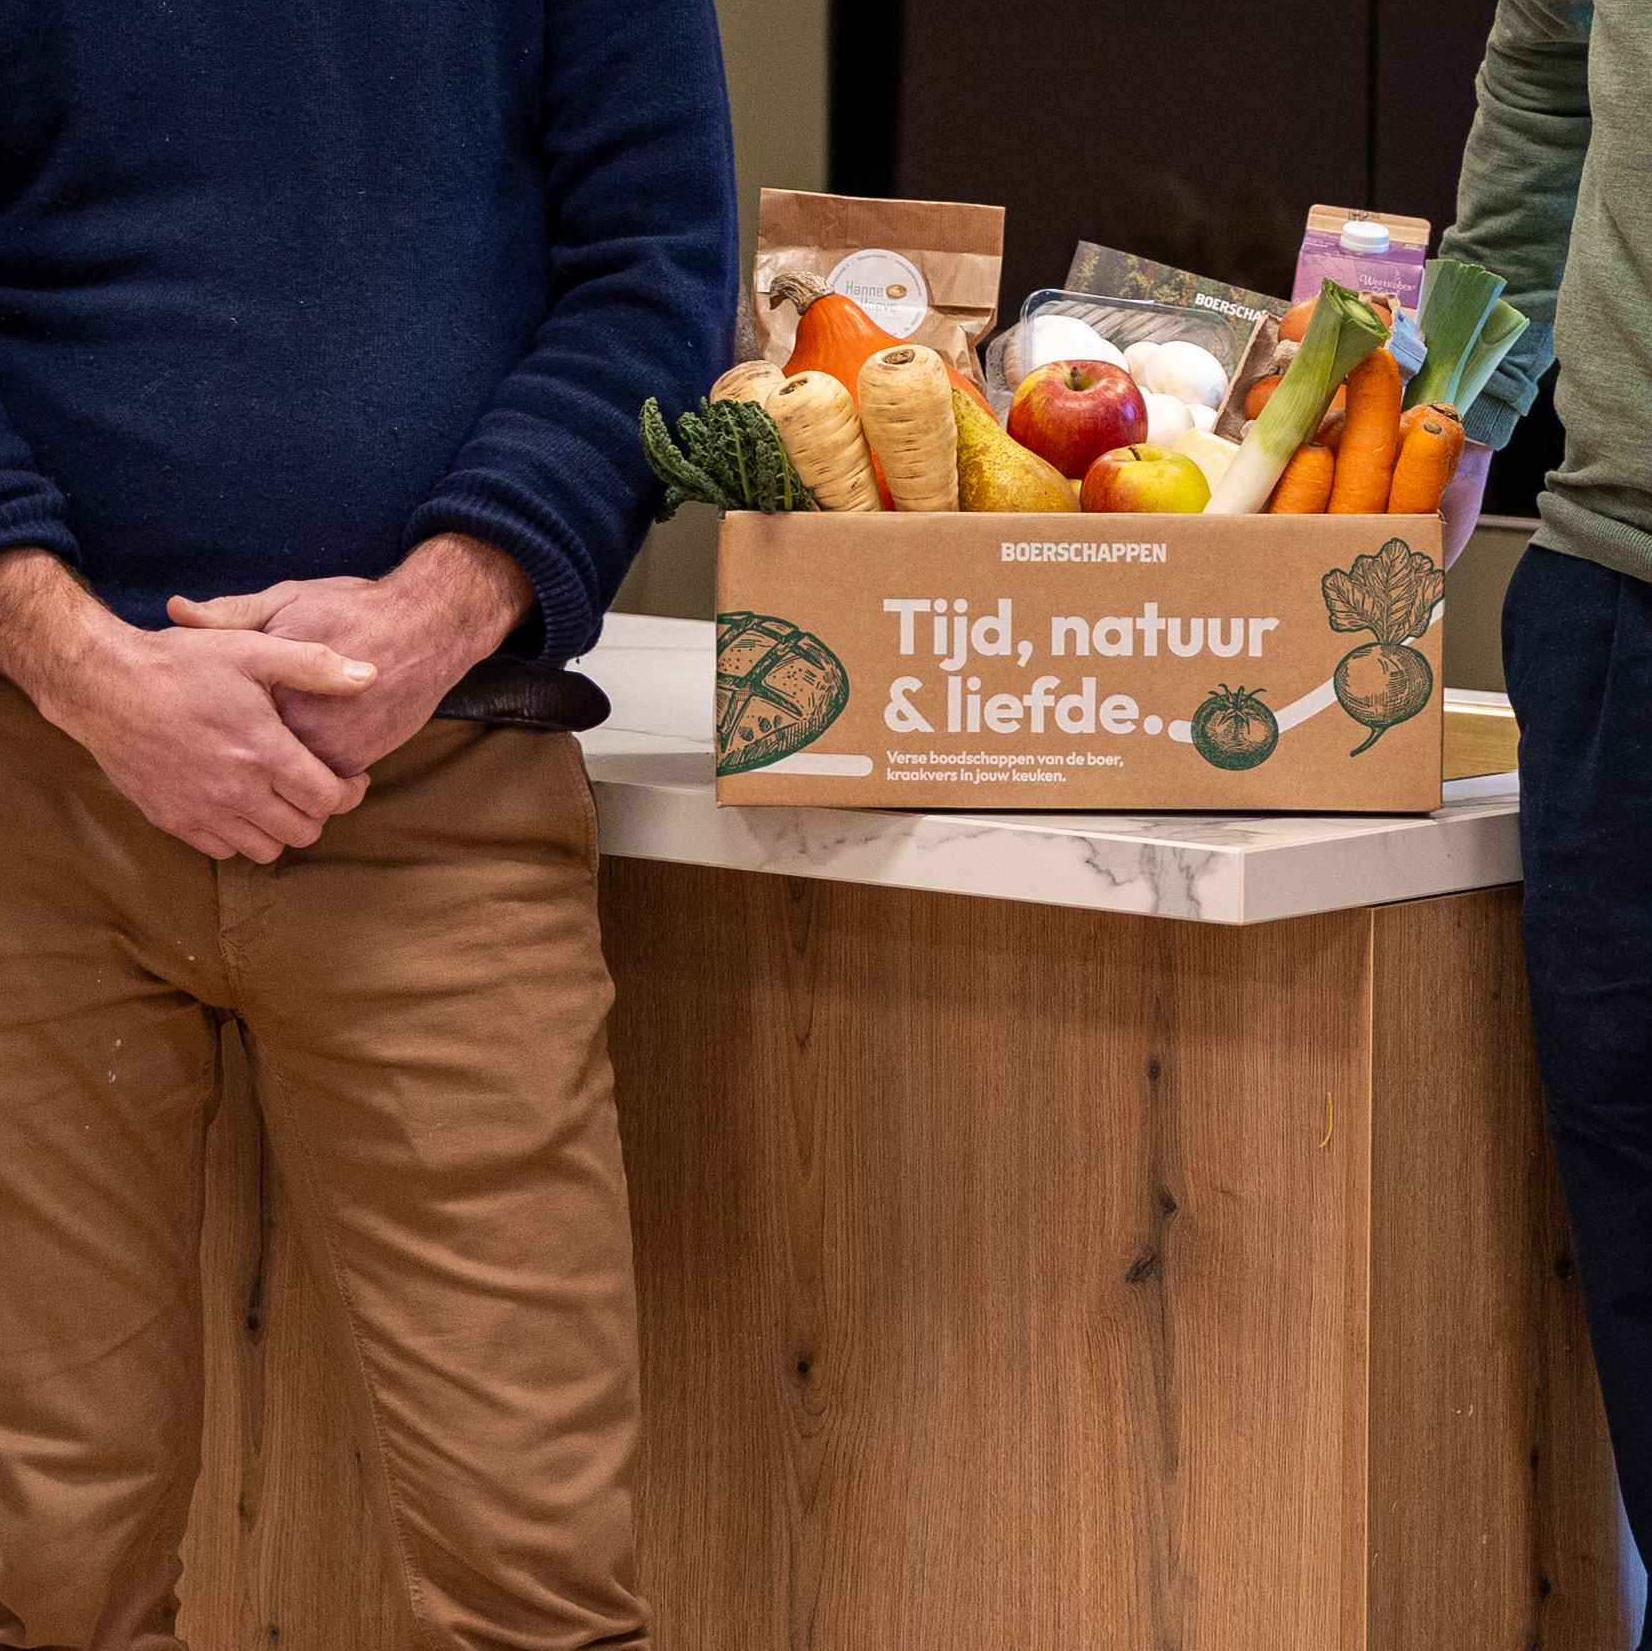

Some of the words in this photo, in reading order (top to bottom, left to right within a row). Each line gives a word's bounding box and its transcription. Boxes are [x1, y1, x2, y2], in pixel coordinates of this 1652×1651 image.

[845, 280, 884, 297] Hanne
[860, 295, 897, 313] Hoeve
[1194, 292, 1264, 322] BOERSCHA
[1000, 542, 1167, 563] BOERSCHAPPEN
[882, 597, 1034, 672] Tijd,
[1051, 601, 1280, 658] natuur
[883, 675, 935, 734] &
[947, 675, 1164, 736] liefde.
[886, 750, 928, 765] Verse
[929, 751, 1035, 768] boodschappen
[1037, 754, 1064, 765] van
[1066, 752, 1085, 766] de
[1087, 752, 1124, 768] boer,
[886, 767, 958, 781] kraakvers
[960, 768, 973, 782] in
[973, 768, 1009, 785] jouw
[1011, 768, 1067, 782] keuken.
